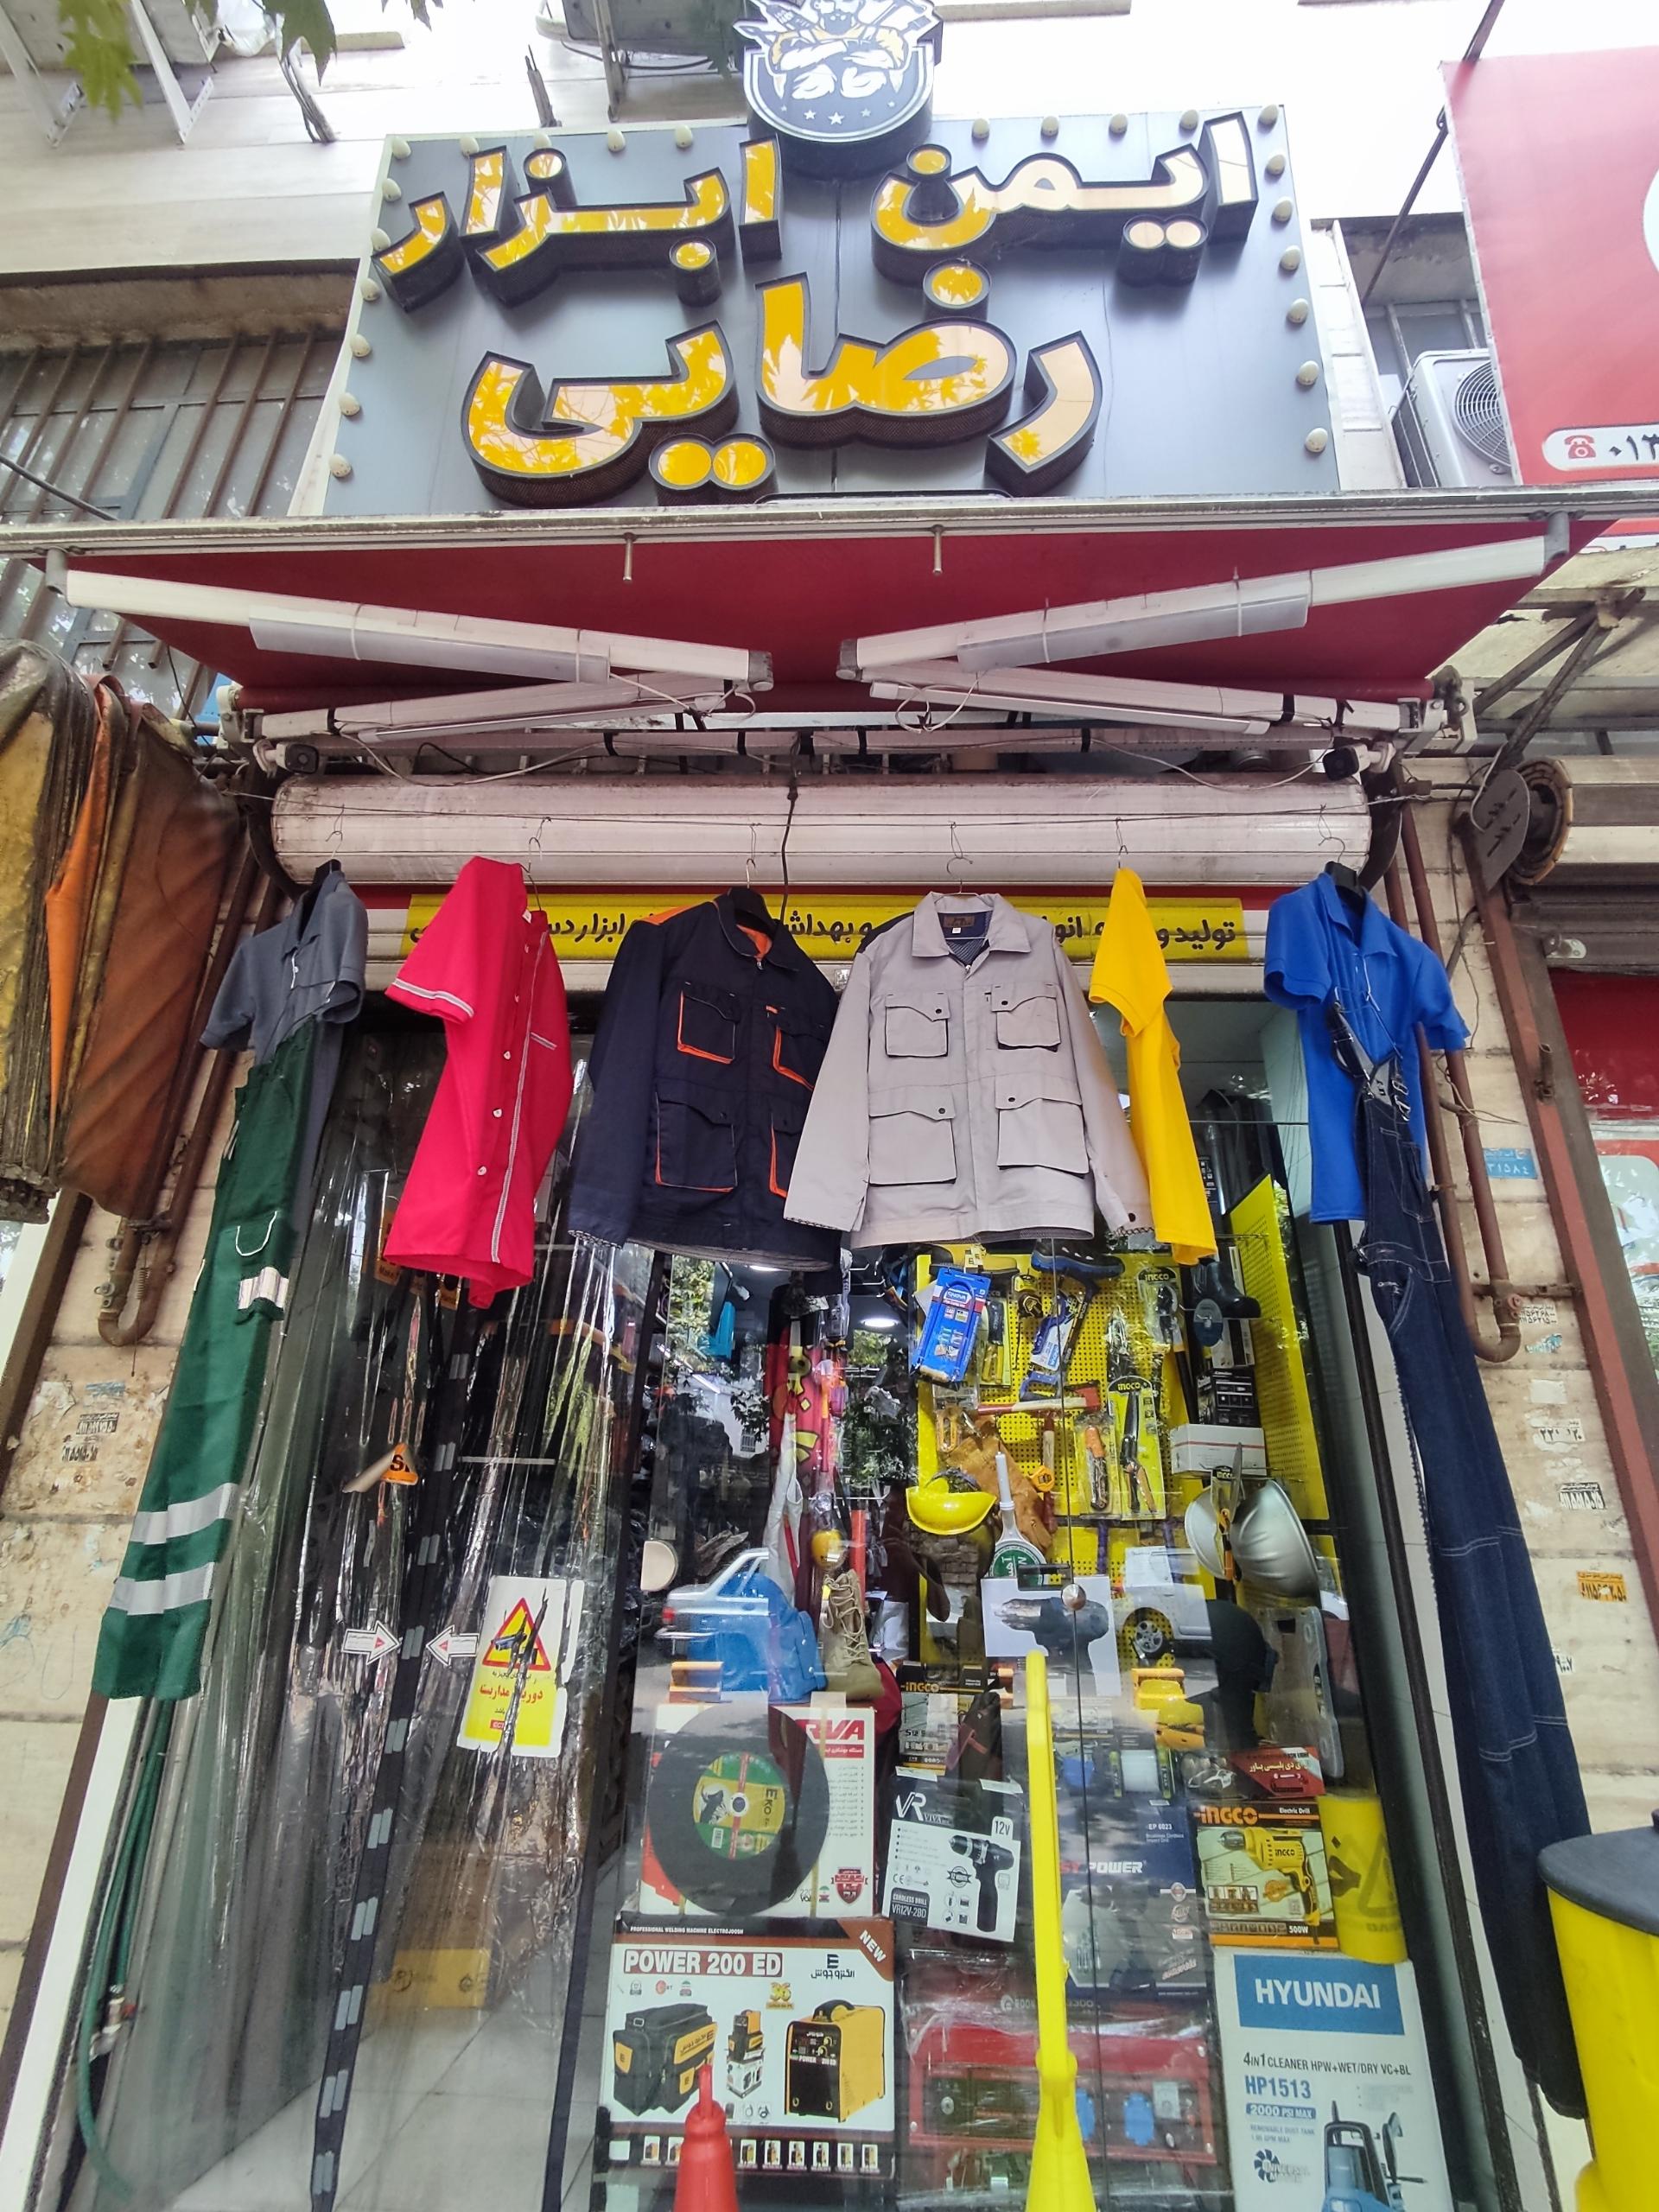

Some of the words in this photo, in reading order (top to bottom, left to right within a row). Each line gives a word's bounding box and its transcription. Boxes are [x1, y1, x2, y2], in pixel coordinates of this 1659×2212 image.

[872, 112, 1259, 266] ایمن
[372, 135, 783, 283] ابزار
[462, 261, 1103, 501] رضایی
[574, 912, 626, 944] ابزار
[1174, 918, 1236, 950] تولید
[858, 1929, 887, 1963] NEW
[625, 1949, 701, 1974] POWER
[707, 1952, 746, 1975] 200
[753, 1953, 782, 1976] ED
[1255, 1978, 1382, 2009] HYUNDAI
[1267, 2058, 1308, 2071] CLEANER
[1244, 2075, 1312, 2099] HP1513
[1250, 2104, 1280, 2117] 2000
[1281, 2108, 1294, 2117] PSI
[1295, 2109, 1313, 2119] MAX
